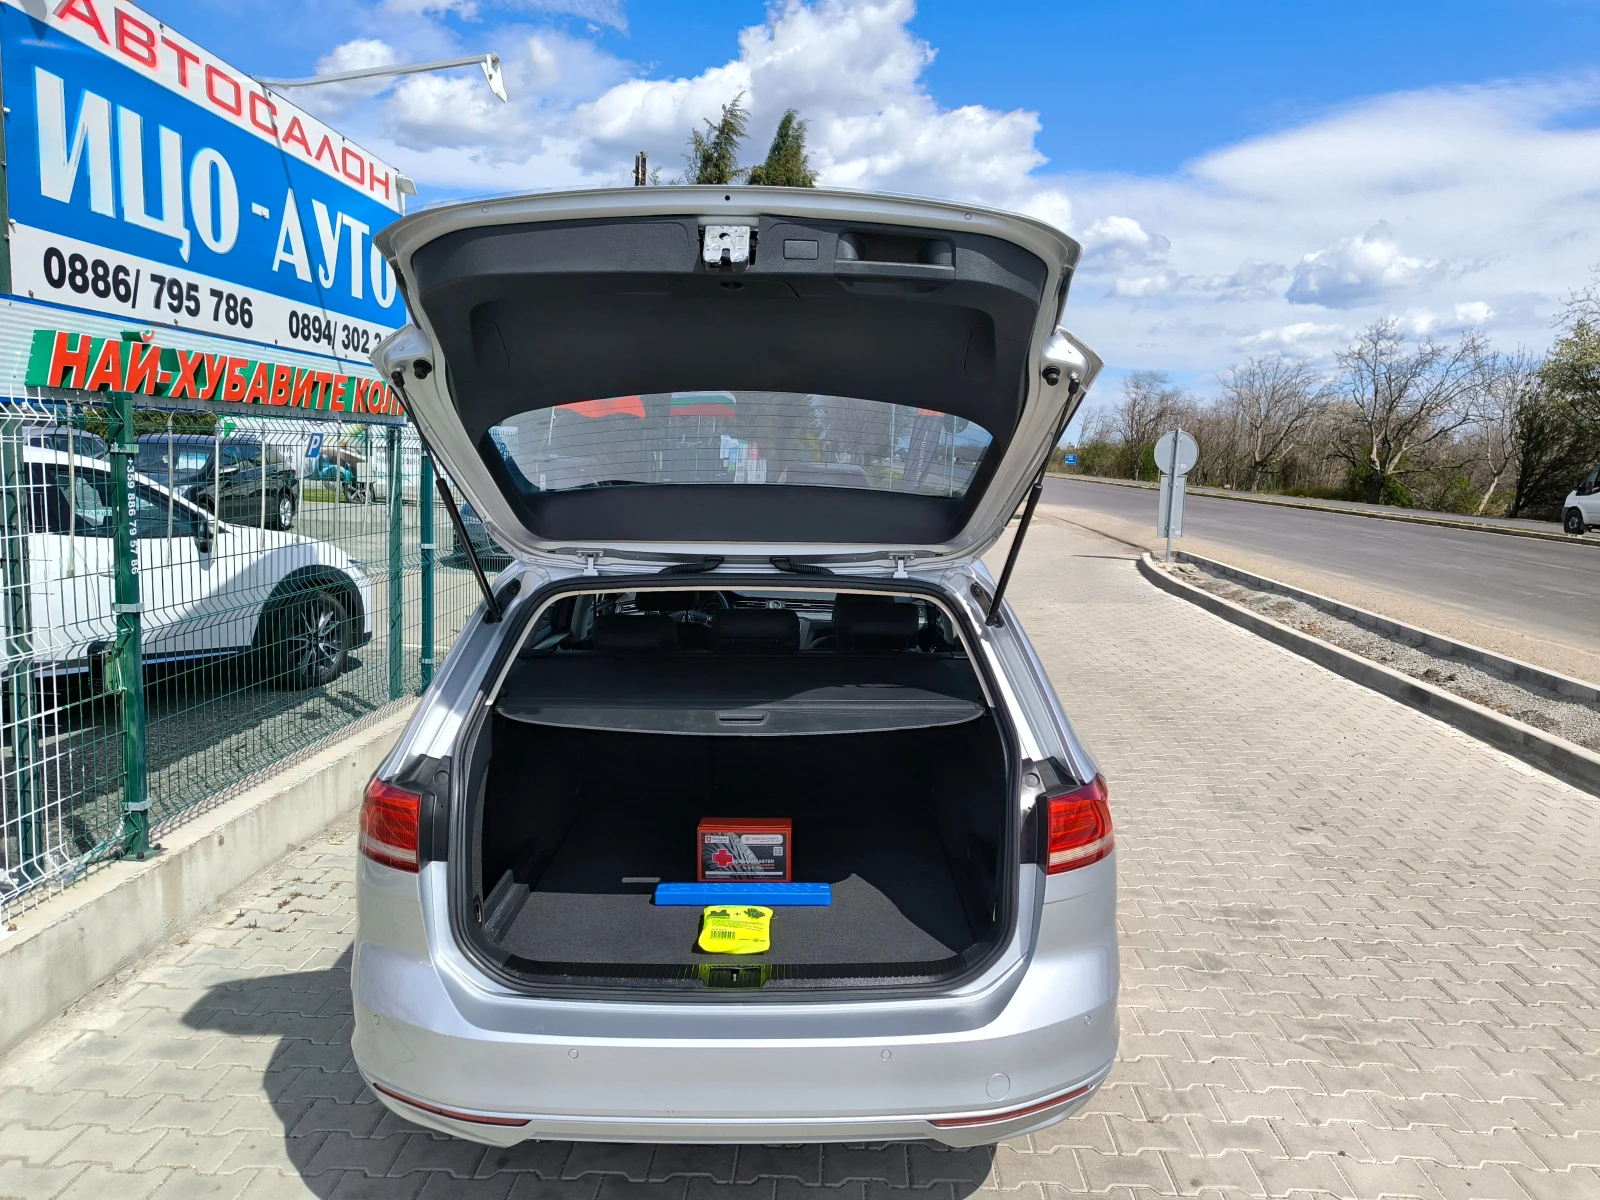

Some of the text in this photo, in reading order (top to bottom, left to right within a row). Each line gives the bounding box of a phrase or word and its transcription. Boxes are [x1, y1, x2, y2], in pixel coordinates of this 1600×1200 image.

[54, 0, 390, 200] АВТОСАЛОН
[43, 247, 254, 329] 0886/ 795 786
[47, 330, 349, 412] НАЙ-ХУБАВИТЕ
[288, 310, 370, 354] 0894/ 302
[309, 435, 320, 456] P
[127, 457, 139, 575] +359 886 79 57 86
